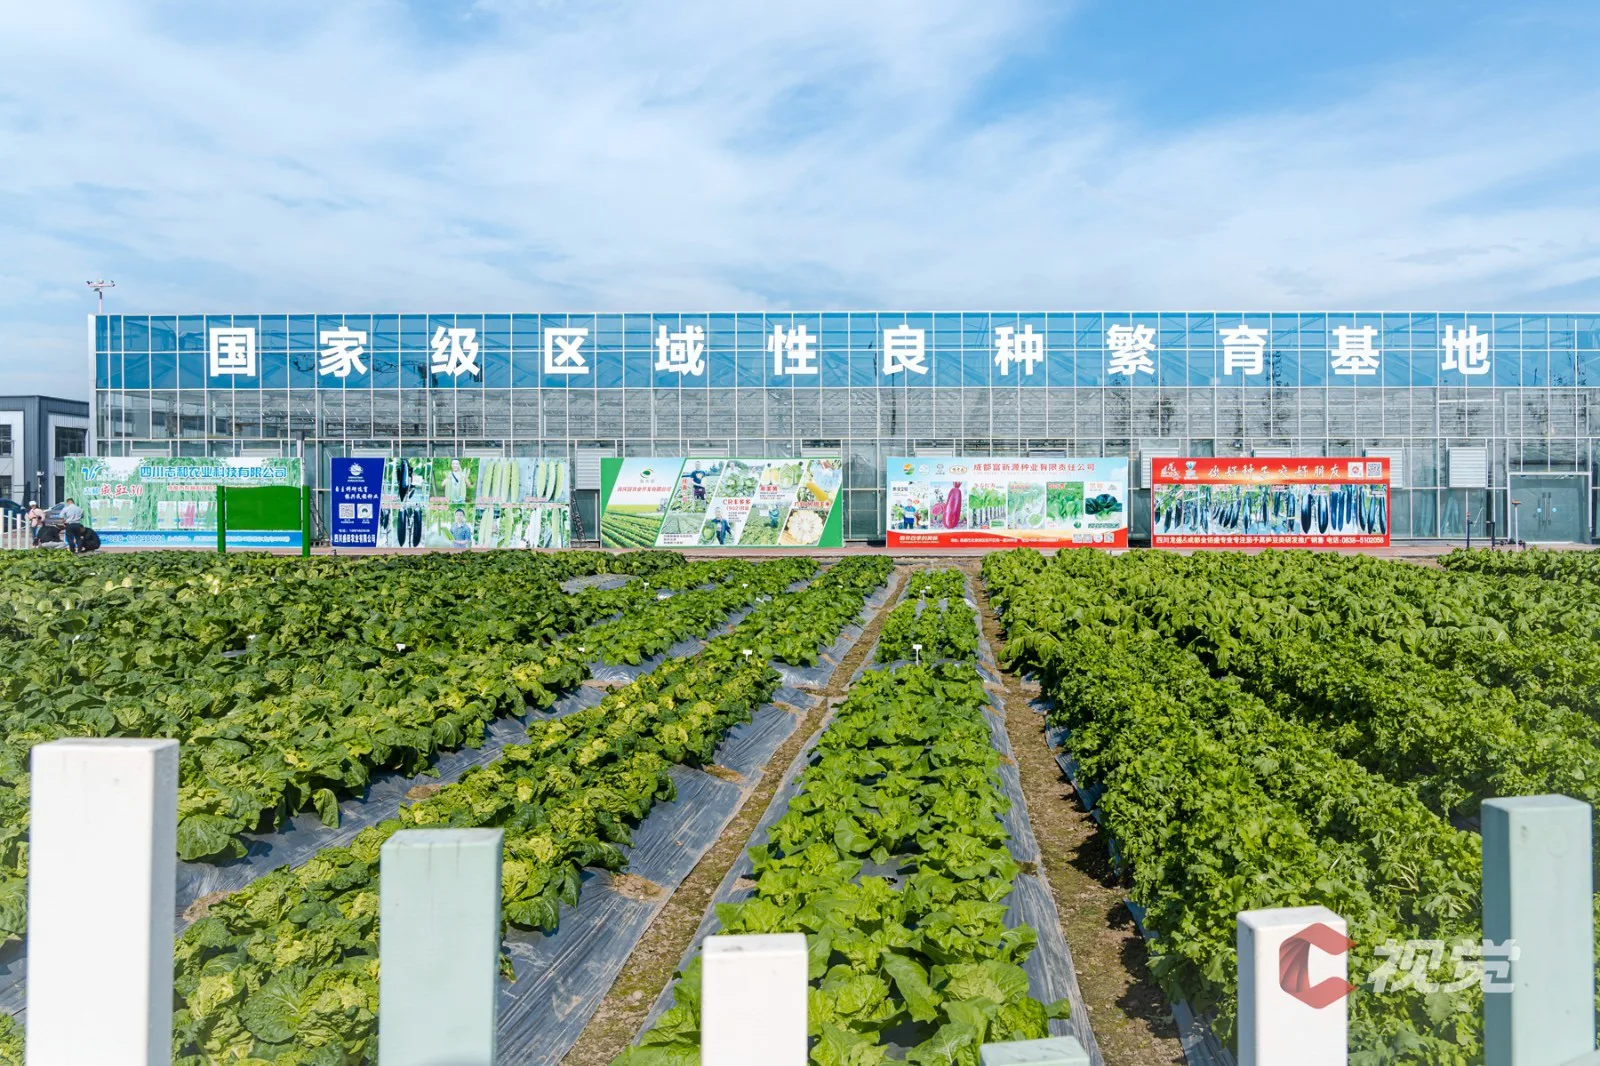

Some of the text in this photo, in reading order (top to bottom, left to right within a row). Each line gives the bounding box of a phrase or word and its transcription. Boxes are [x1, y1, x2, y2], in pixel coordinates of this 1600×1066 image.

[208, 324, 1492, 378] 国家级区域性良种繁育基地
[140, 466, 287, 478] 四川志和农业科技有限公司
[973, 463, 1095, 471] 成都富新源种业有限责任公司
